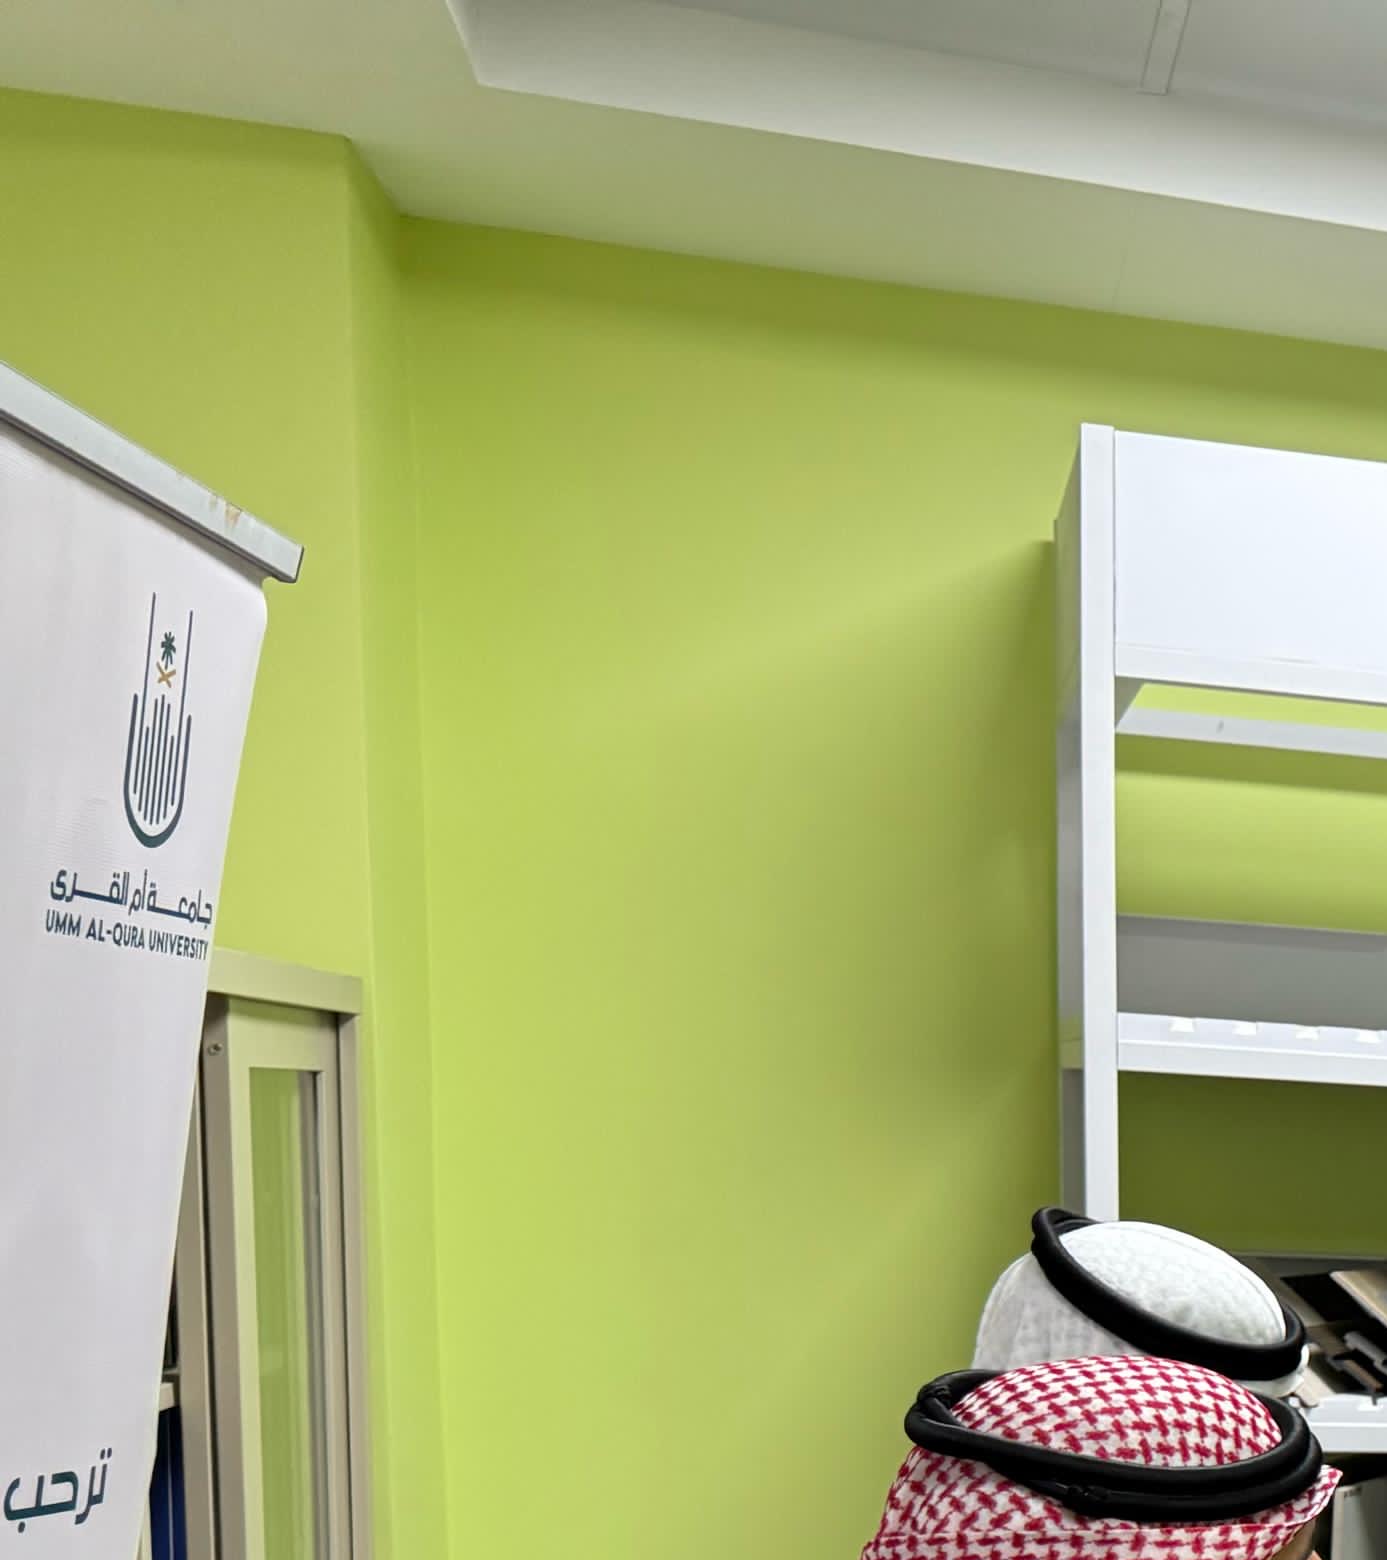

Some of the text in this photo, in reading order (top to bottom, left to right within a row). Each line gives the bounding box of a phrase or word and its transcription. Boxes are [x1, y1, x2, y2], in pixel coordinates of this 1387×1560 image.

[50, 868, 213, 929] جامعة أم القرى
[45, 908, 209, 961] UMM AL-QURA UNIVERSITY
[3, 1447, 113, 1534] ترحب
